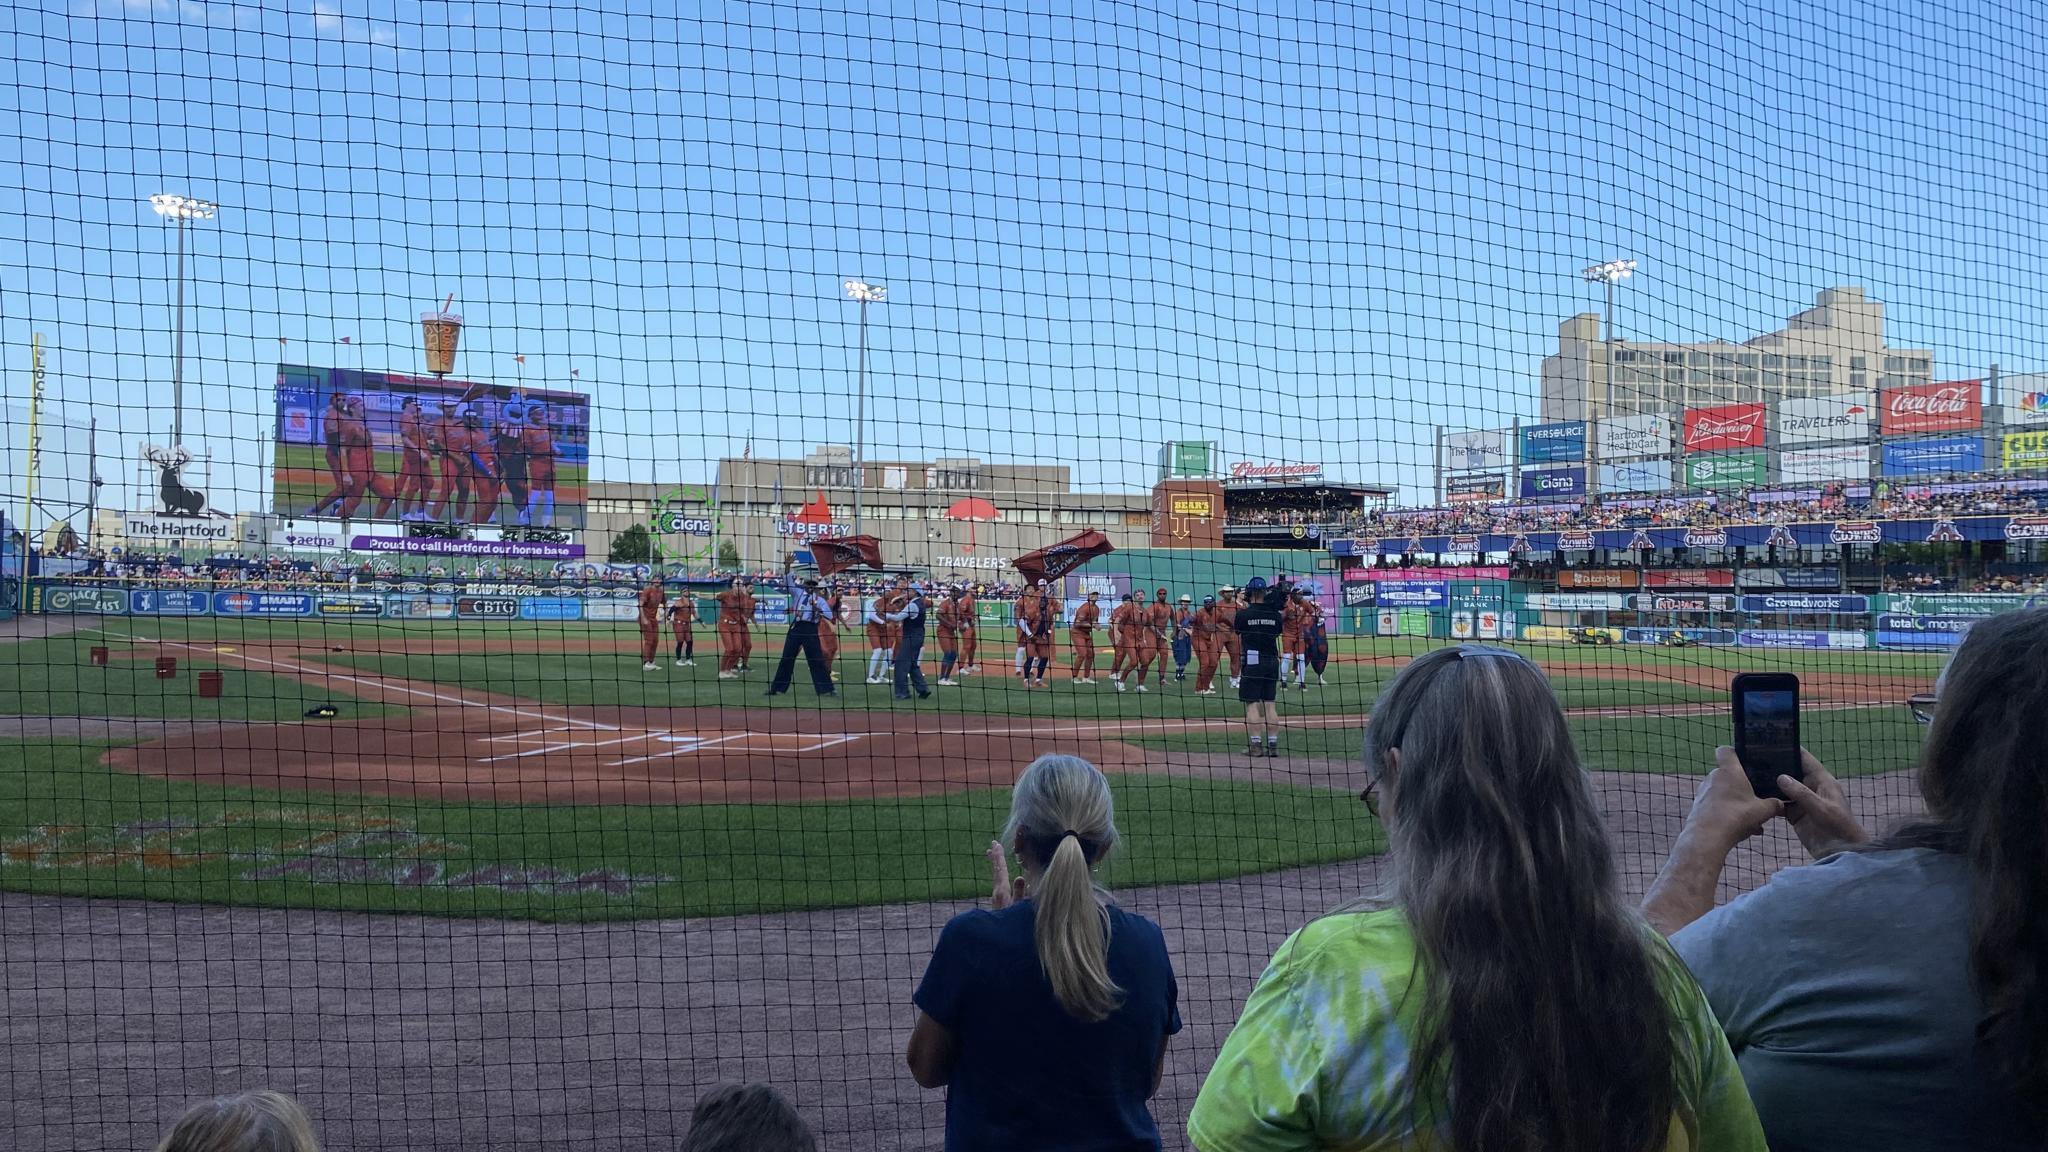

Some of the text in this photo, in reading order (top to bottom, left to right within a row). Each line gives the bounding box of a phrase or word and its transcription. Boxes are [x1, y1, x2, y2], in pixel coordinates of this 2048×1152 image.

[35, 356, 46, 415] LOCAL
[1694, 421, 1752, 437] Budweiser
[1783, 414, 1851, 431] TRAVELERS
[1527, 426, 1584, 440] EVERSOURCE
[1607, 428, 1647, 441] Hartford
[1451, 443, 1501, 457] The Hartford
[1607, 439, 1660, 451] HealthCare
[1231, 461, 1321, 477] Budweiser
[128, 520, 226, 538] The Hartford
[777, 520, 850, 536] LIBERTY
[298, 536, 335, 547] aetna
[1686, 534, 1726, 546] CLOWNS
[1834, 530, 1879, 542] CLOWNS
[370, 538, 569, 556] Proud to call Hartford our home base
[1450, 542, 1479, 552] CLOWNS
[1560, 538, 1594, 549] CLOWNS
[936, 556, 1007, 569] TRAVELERS
[94, 600, 121, 611] EAST
[473, 600, 514, 613] CBTG
[1765, 597, 1840, 609] Groundworks
[1889, 617, 1915, 629] total
